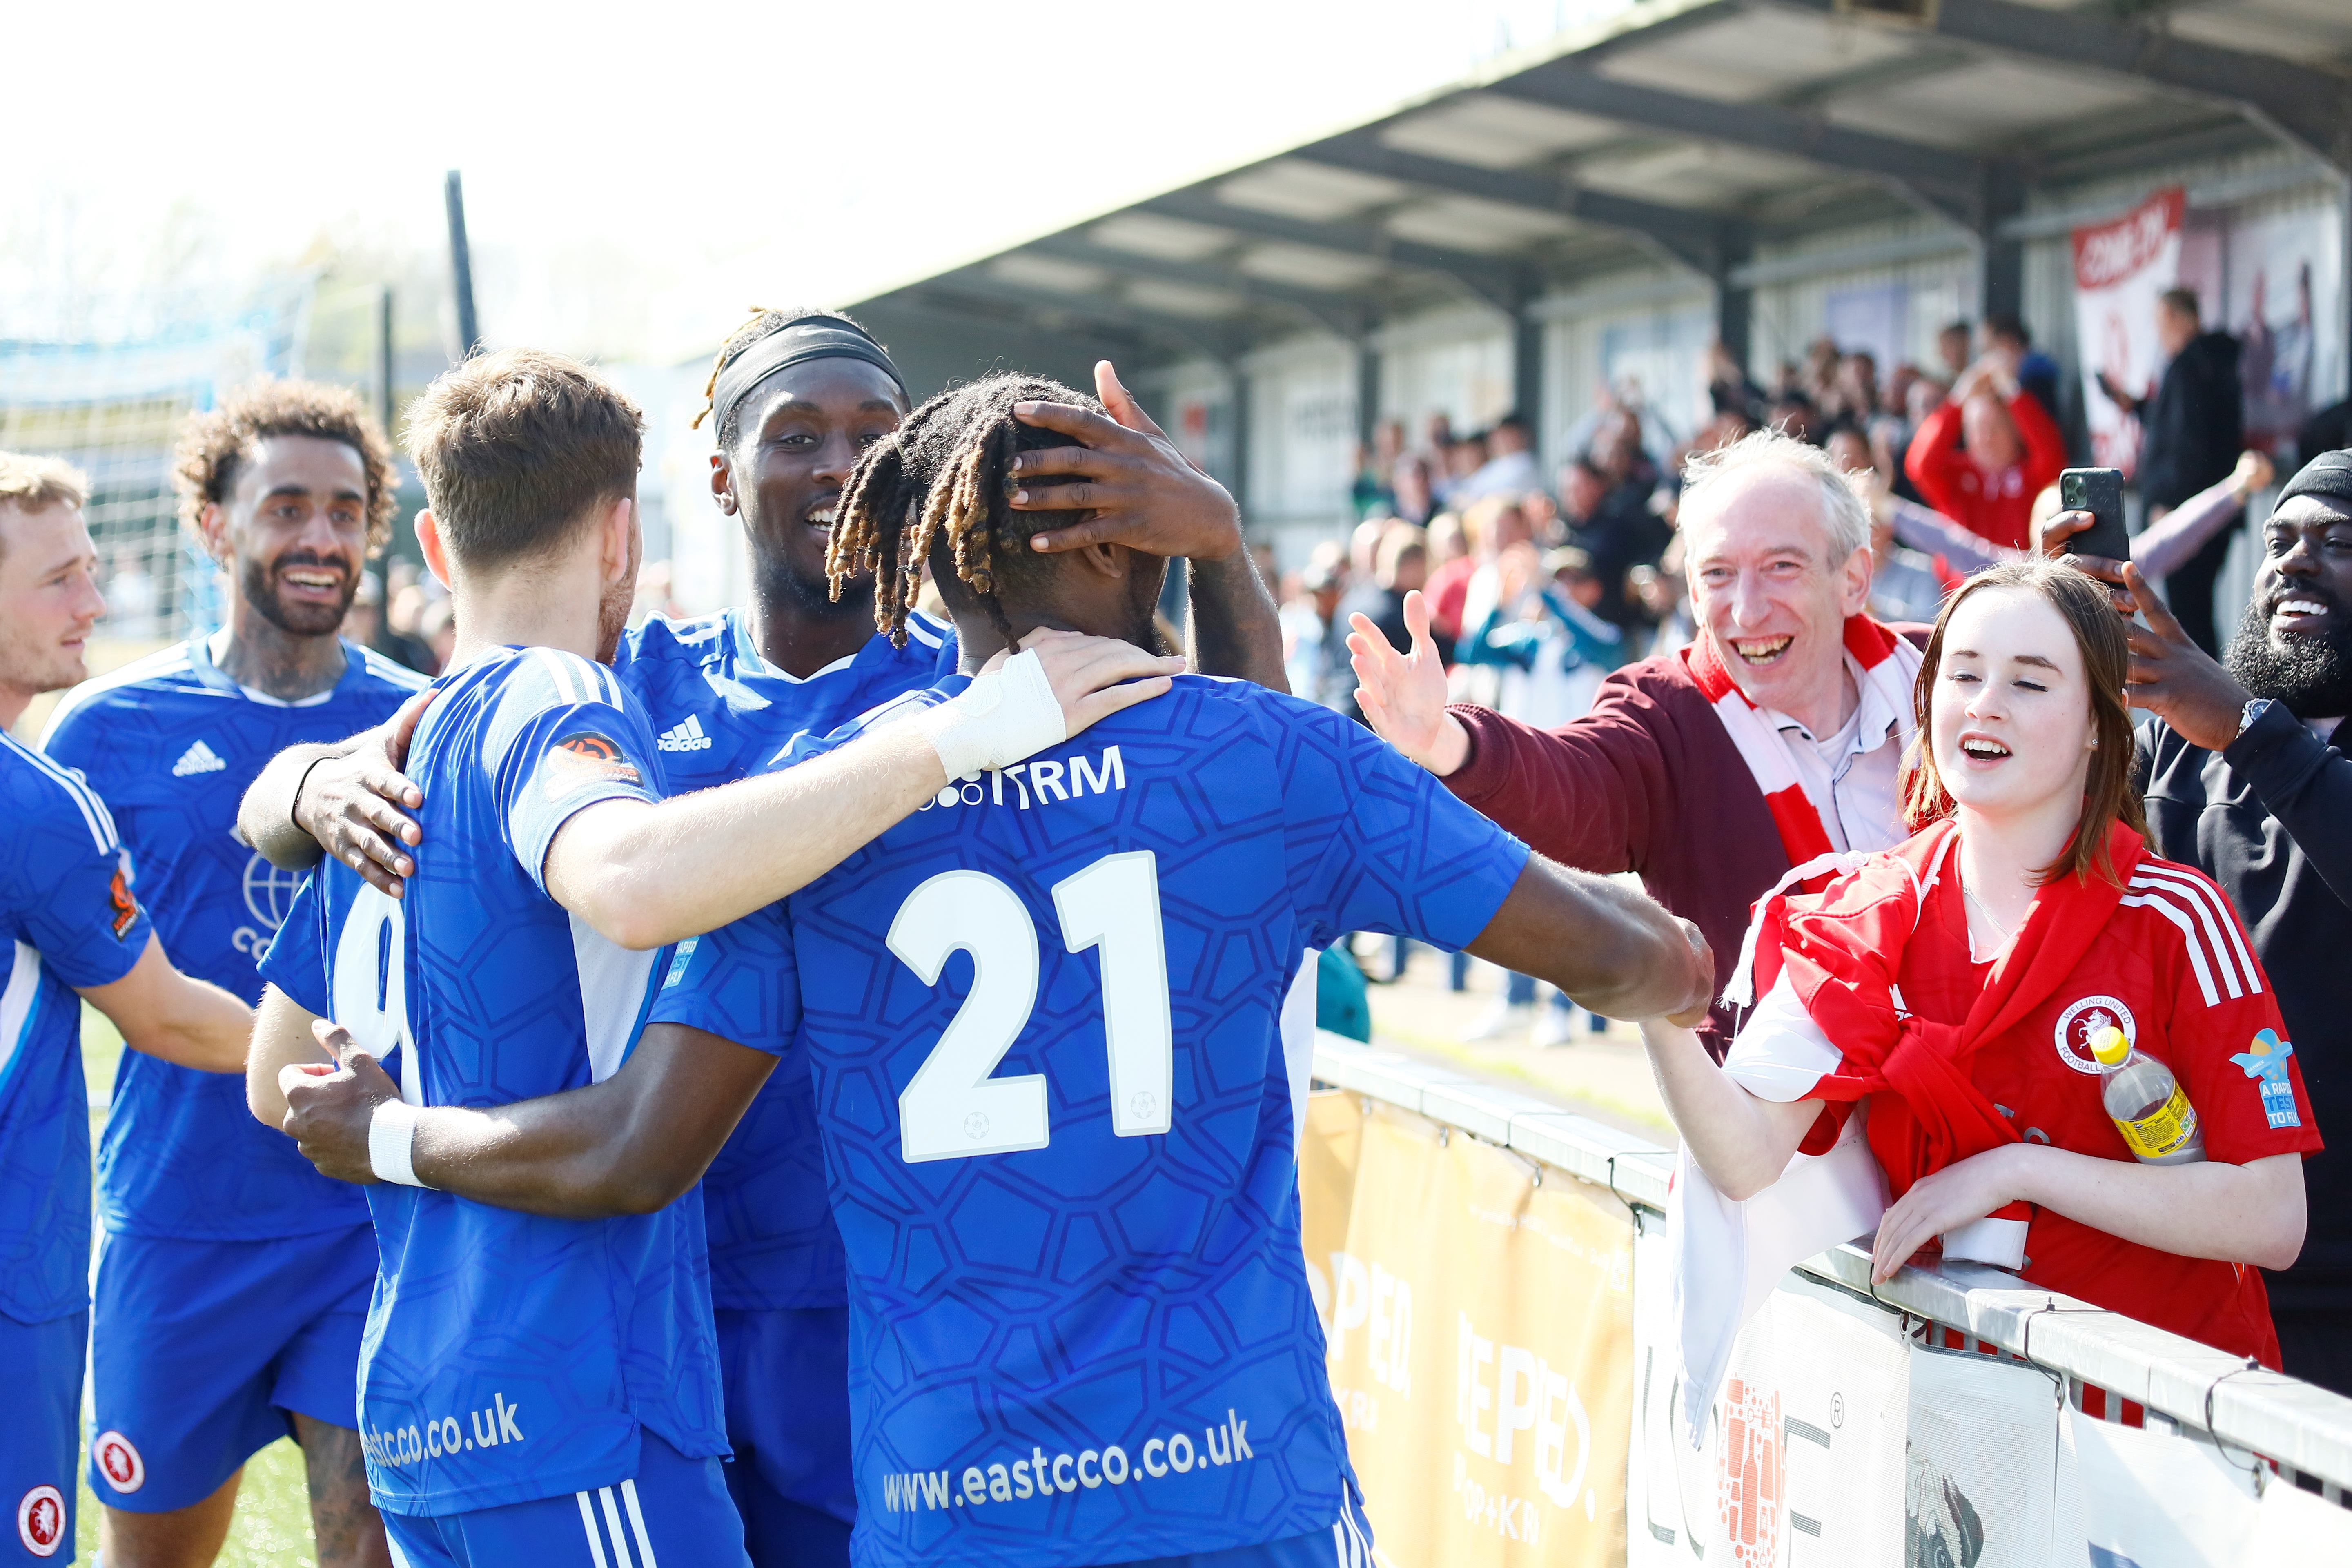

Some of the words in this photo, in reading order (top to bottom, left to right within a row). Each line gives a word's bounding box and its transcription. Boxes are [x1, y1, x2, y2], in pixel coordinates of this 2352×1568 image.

[657, 735, 712, 751] adidas
[677, 941, 697, 953] APID
[671, 953, 691, 971] EST
[885, 849, 1173, 1164] 21
[2063, 997, 2102, 1020] WELLING
[2104, 998, 2131, 1024] UNITED
[2059, 1046, 2101, 1071] FOOTBALL
[2247, 1060, 2265, 1073] GATWICK
[2262, 1084, 2271, 1096] A
[2272, 1082, 2292, 1094] RAPID
[2264, 1095, 2294, 1111] TEST
[2154, 1115, 2166, 1125] 500ml
[2268, 1112, 2286, 1125] TO
[2288, 1111, 2299, 1123] FLY
[883, 1408, 1254, 1513] www.eastcco.co.uk
